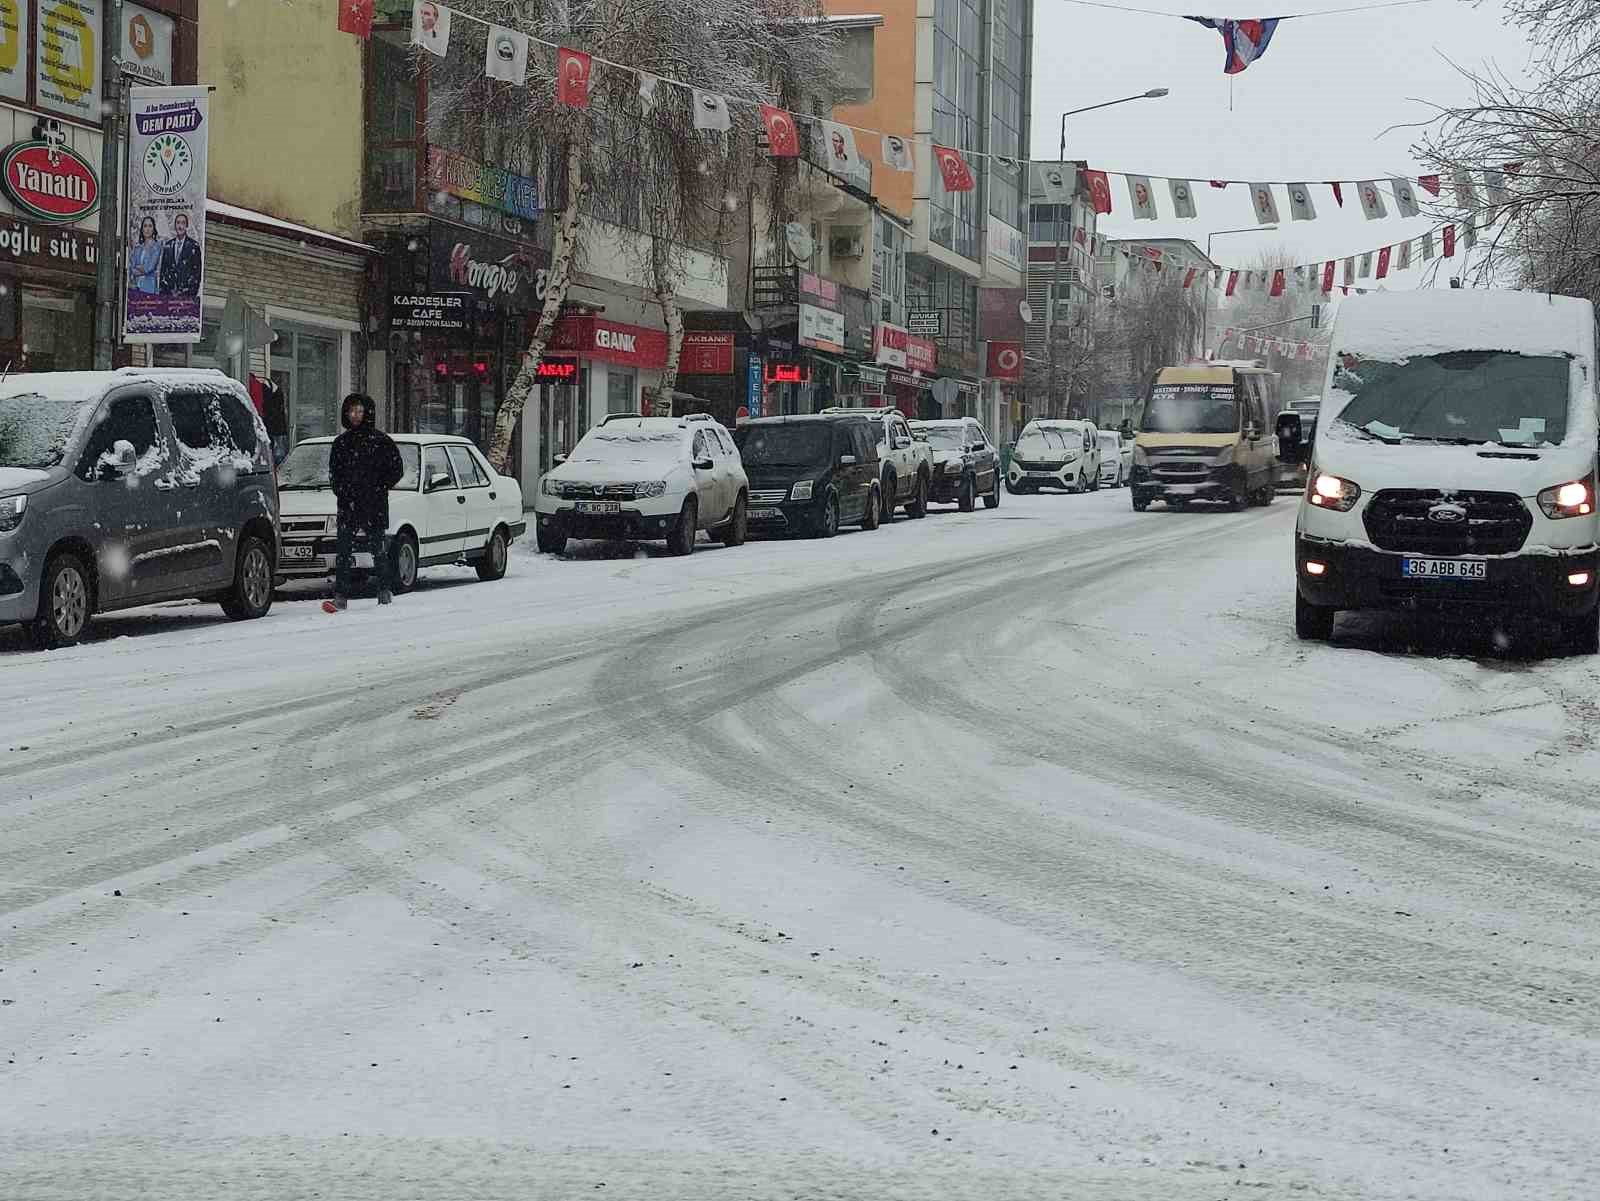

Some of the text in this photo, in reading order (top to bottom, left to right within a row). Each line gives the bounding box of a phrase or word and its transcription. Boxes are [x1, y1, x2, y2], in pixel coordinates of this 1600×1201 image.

[142, 116, 164, 133] DEM
[16, 162, 88, 202] Yanatlı
[49, 232, 78, 260] süt
[393, 295, 462, 308] KARDEŞLER
[412, 308, 442, 319] CAFE
[687, 335, 729, 343] AKBANK
[294, 546, 312, 557] 492
[1410, 561, 1485, 577] 36 ABB 645
